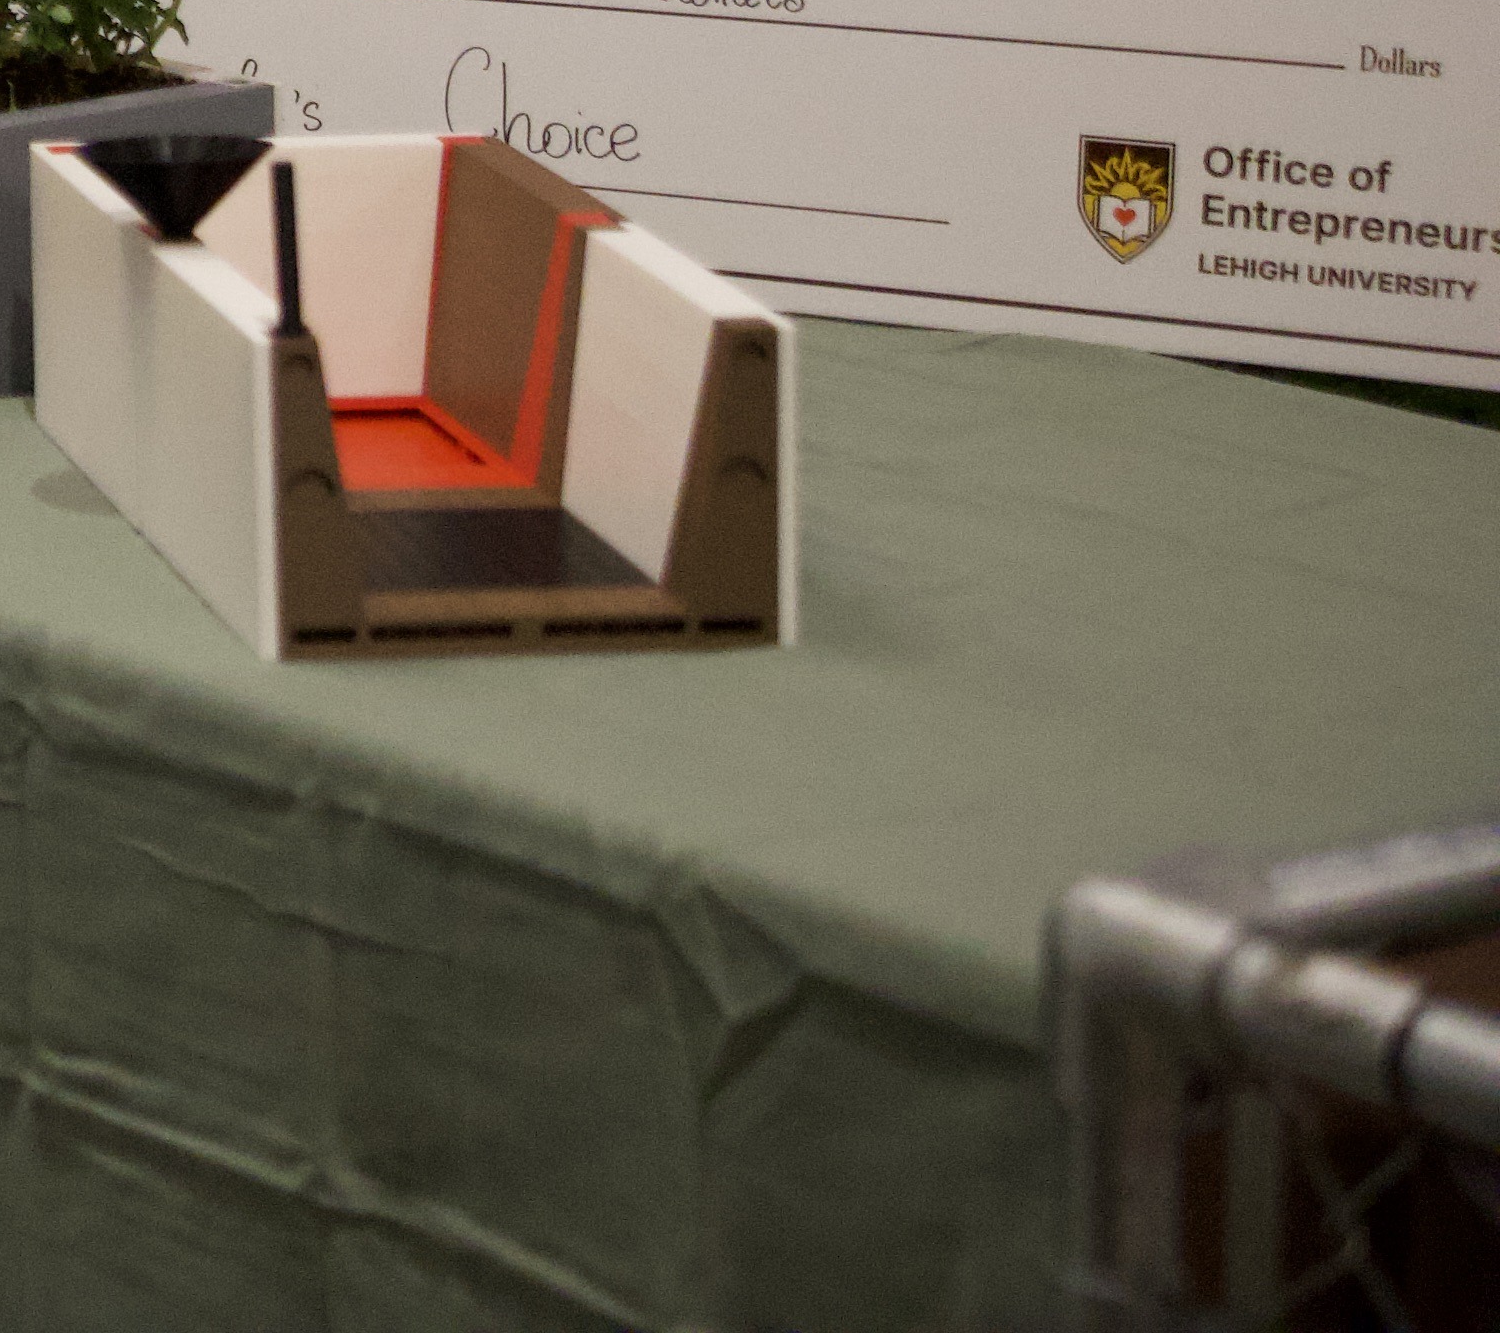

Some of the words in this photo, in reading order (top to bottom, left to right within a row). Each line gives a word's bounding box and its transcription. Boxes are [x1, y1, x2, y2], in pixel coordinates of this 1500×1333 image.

[1359, 44, 1442, 79] Dollars
[444, 46, 642, 163] Choice
[1203, 146, 1334, 188] Office
[1349, 160, 1392, 193] of
[1199, 253, 1299, 283] LEHIGH
[1307, 264, 1478, 302] UNIVERSITY
